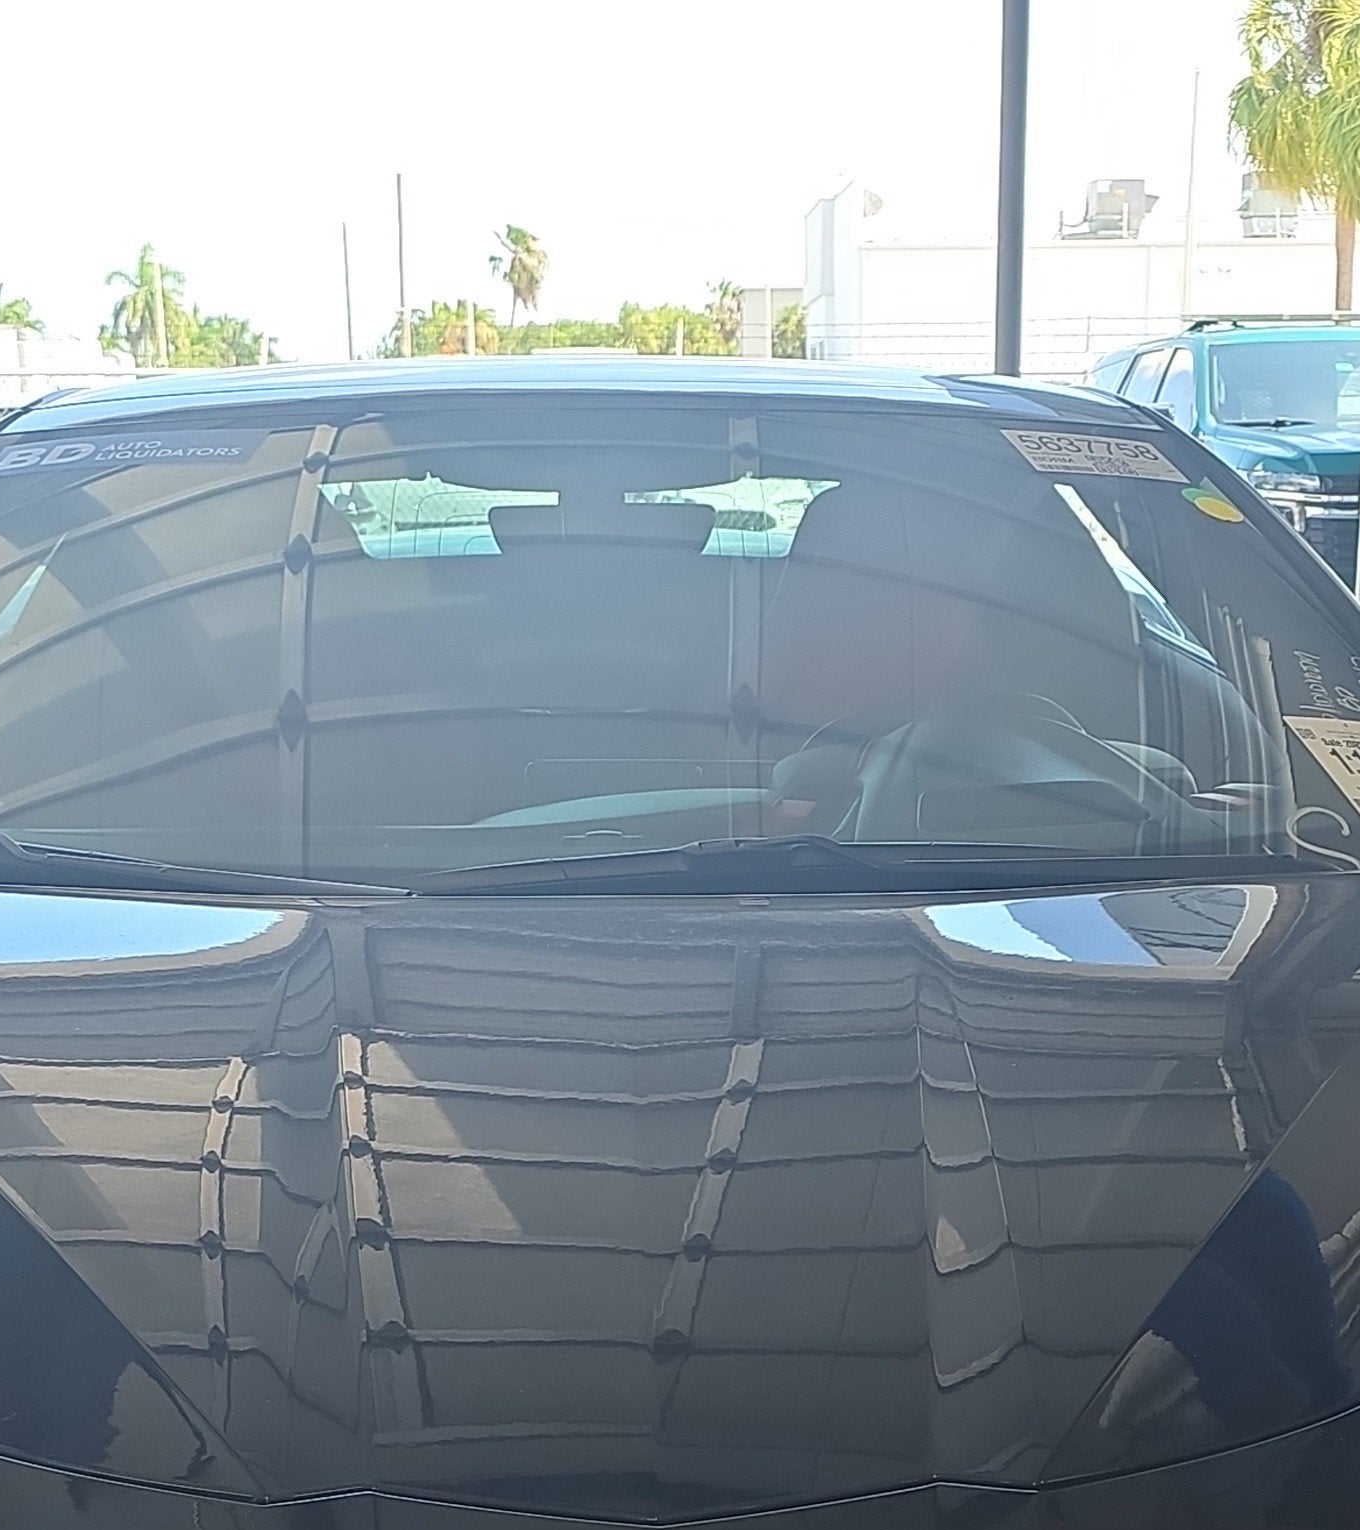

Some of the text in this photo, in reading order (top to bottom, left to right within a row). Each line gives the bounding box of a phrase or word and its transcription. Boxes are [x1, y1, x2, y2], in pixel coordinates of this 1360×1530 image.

[94, 446, 243, 461] LIQUIDATORS
[102, 440, 163, 452] AUTO
[1016, 433, 1160, 461] 5637758
